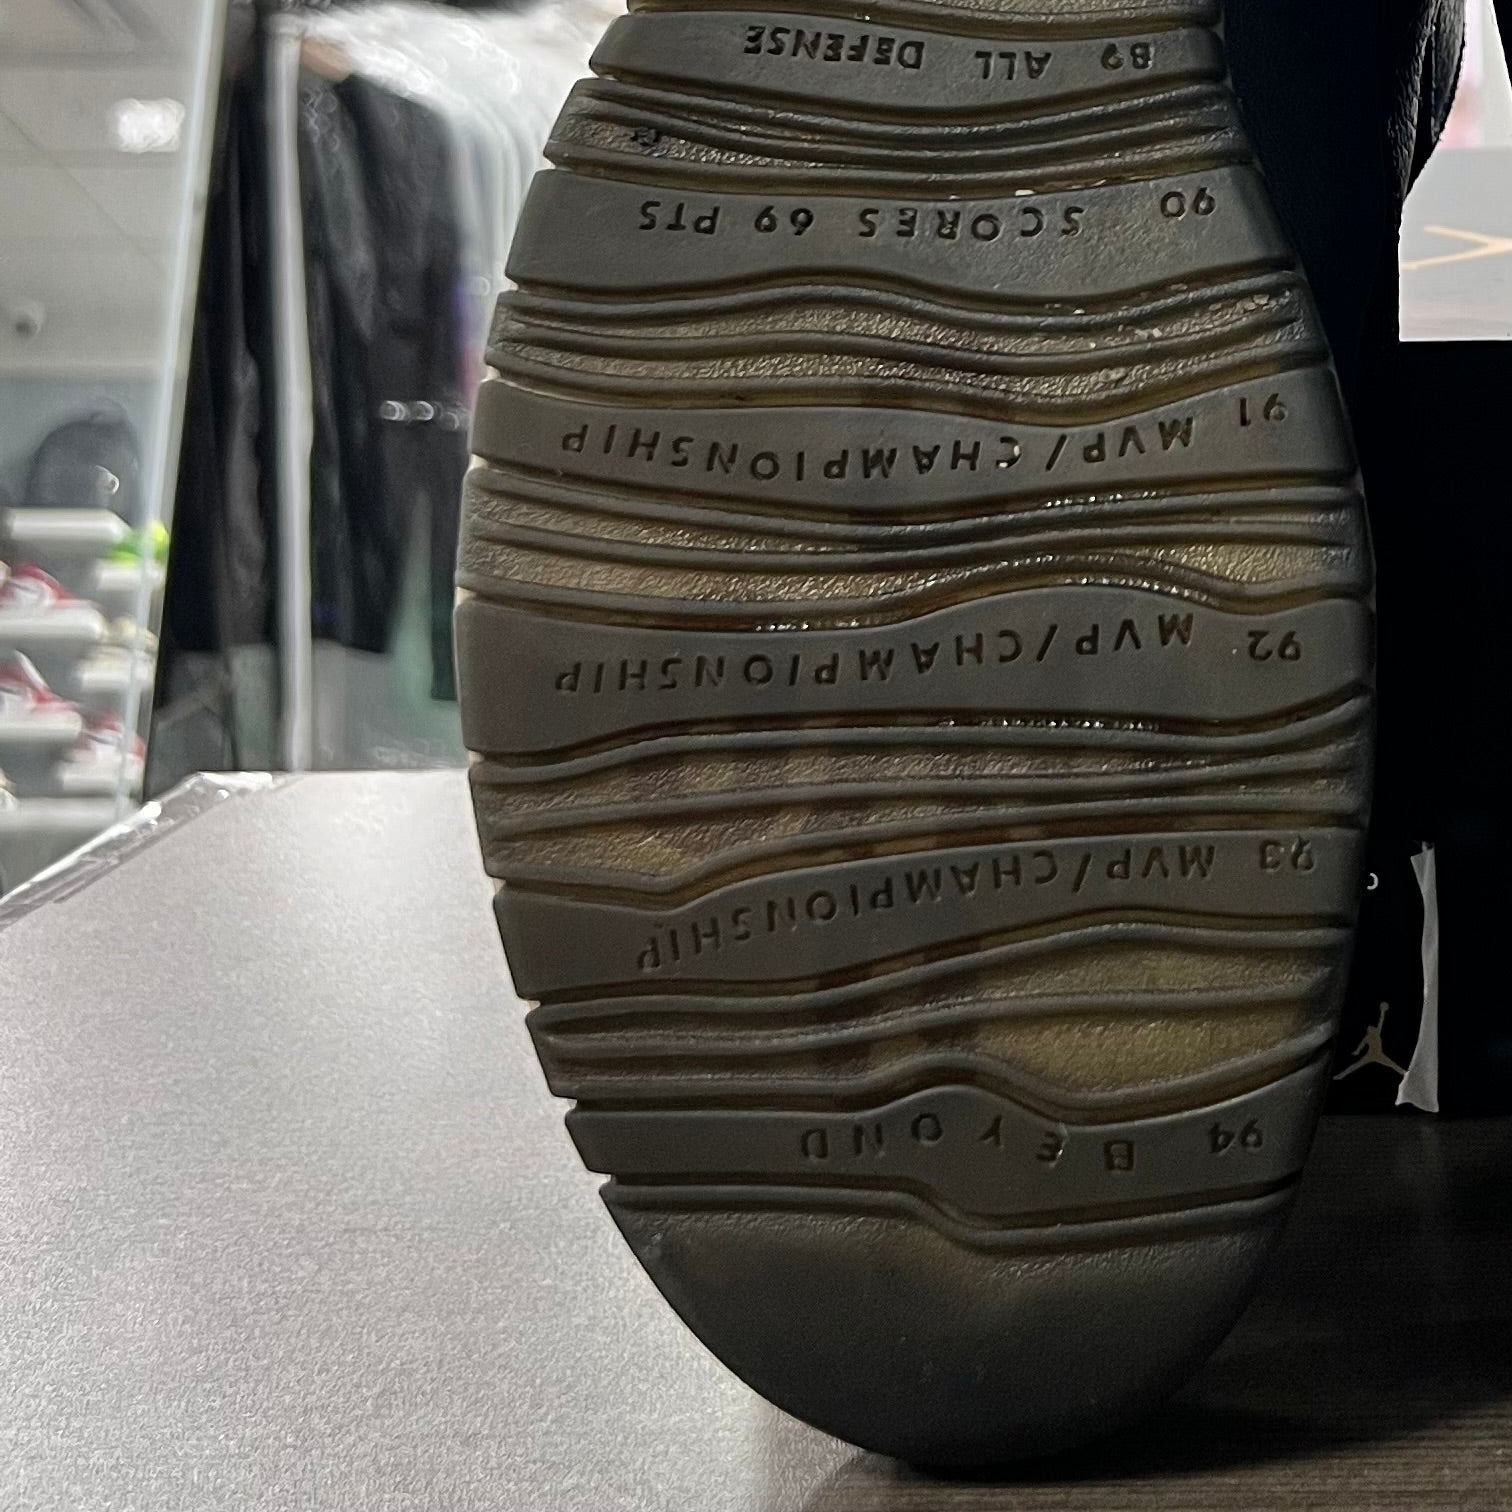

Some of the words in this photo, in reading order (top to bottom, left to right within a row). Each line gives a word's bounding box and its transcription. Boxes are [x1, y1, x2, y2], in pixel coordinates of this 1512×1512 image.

[742, 25, 925, 70] DEFENSE
[974, 50, 1052, 80] ALL
[1100, 41, 1153, 70] 89
[637, 200, 719, 236] PTS
[753, 204, 815, 236] 69
[1158, 188, 1217, 219] 90
[857, 206, 1084, 243] SCORES
[1235, 393, 1288, 430] 91
[1245, 629, 1303, 663] 92
[1258, 837, 1316, 873] 93
[801, 1112, 1136, 1172] BEYOND
[1208, 1117, 1264, 1156] 94
